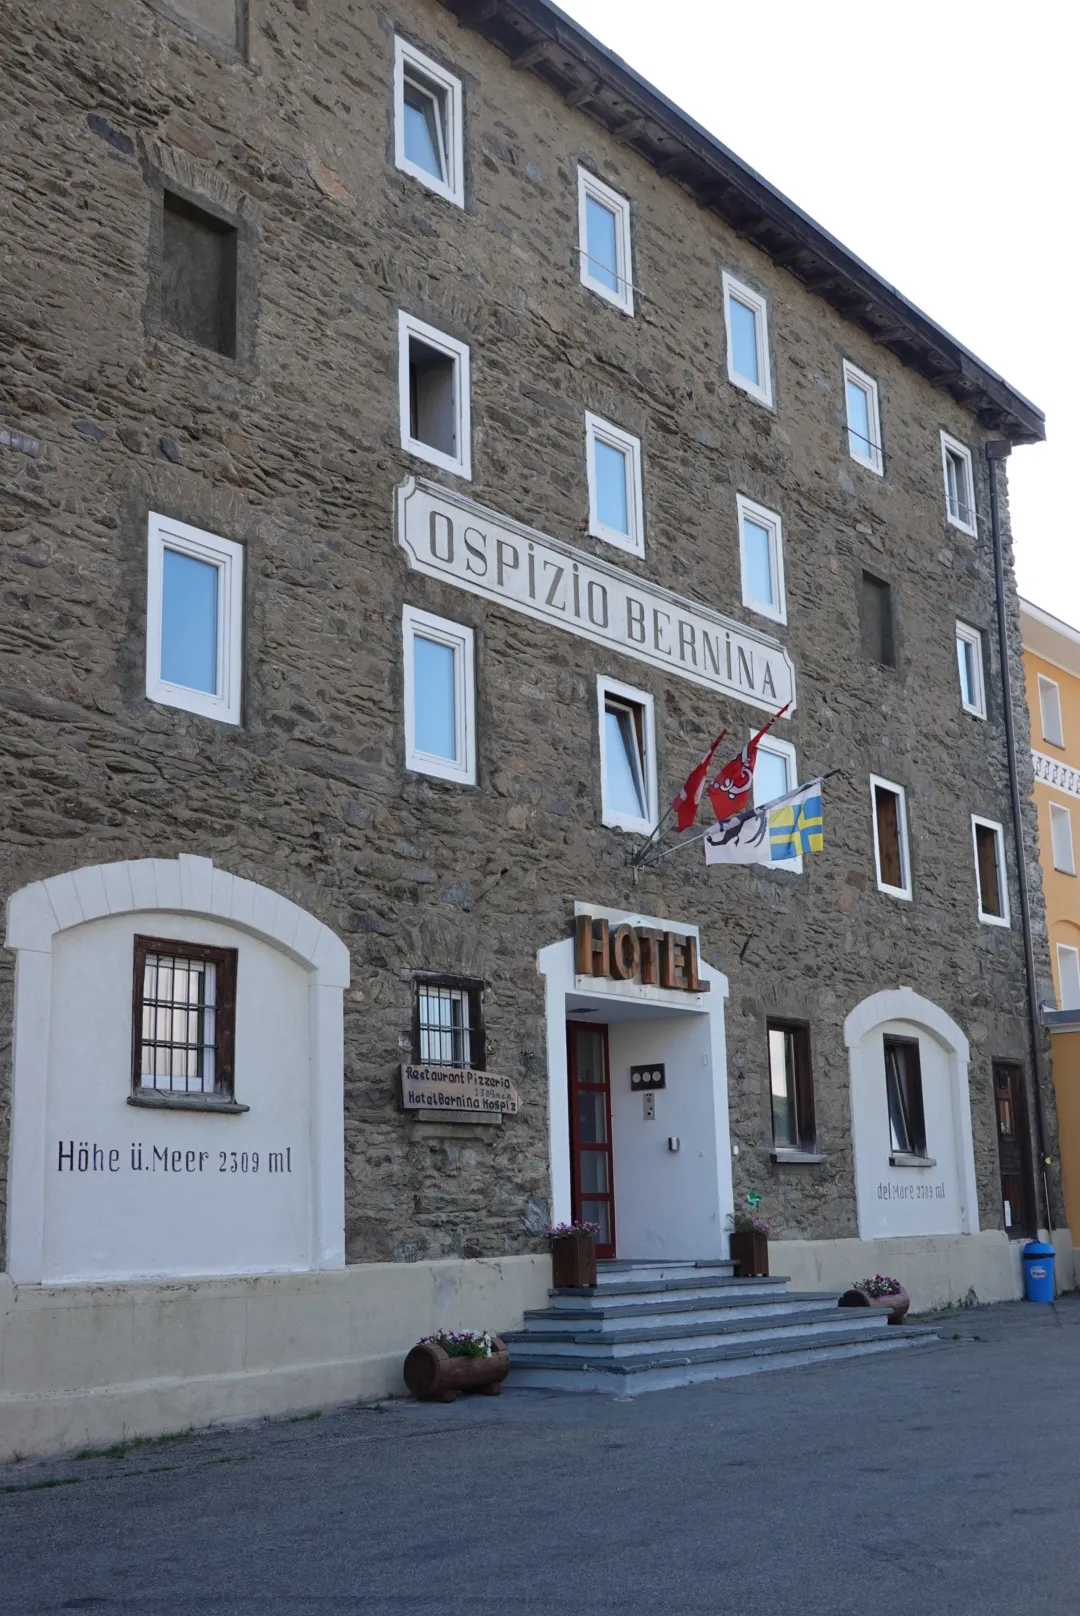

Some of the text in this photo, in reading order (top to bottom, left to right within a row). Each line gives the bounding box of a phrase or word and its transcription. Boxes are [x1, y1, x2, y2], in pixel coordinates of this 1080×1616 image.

[575, 914, 711, 993] HOTEL
[405, 1066, 510, 1088] Restaurant Pizzeria
[408, 1091, 516, 1111] Hotel Bernina Hospiz
[58, 1141, 120, 1172] Höhe
[219, 1151, 260, 1173] 2309
[268, 1147, 292, 1173] ml
